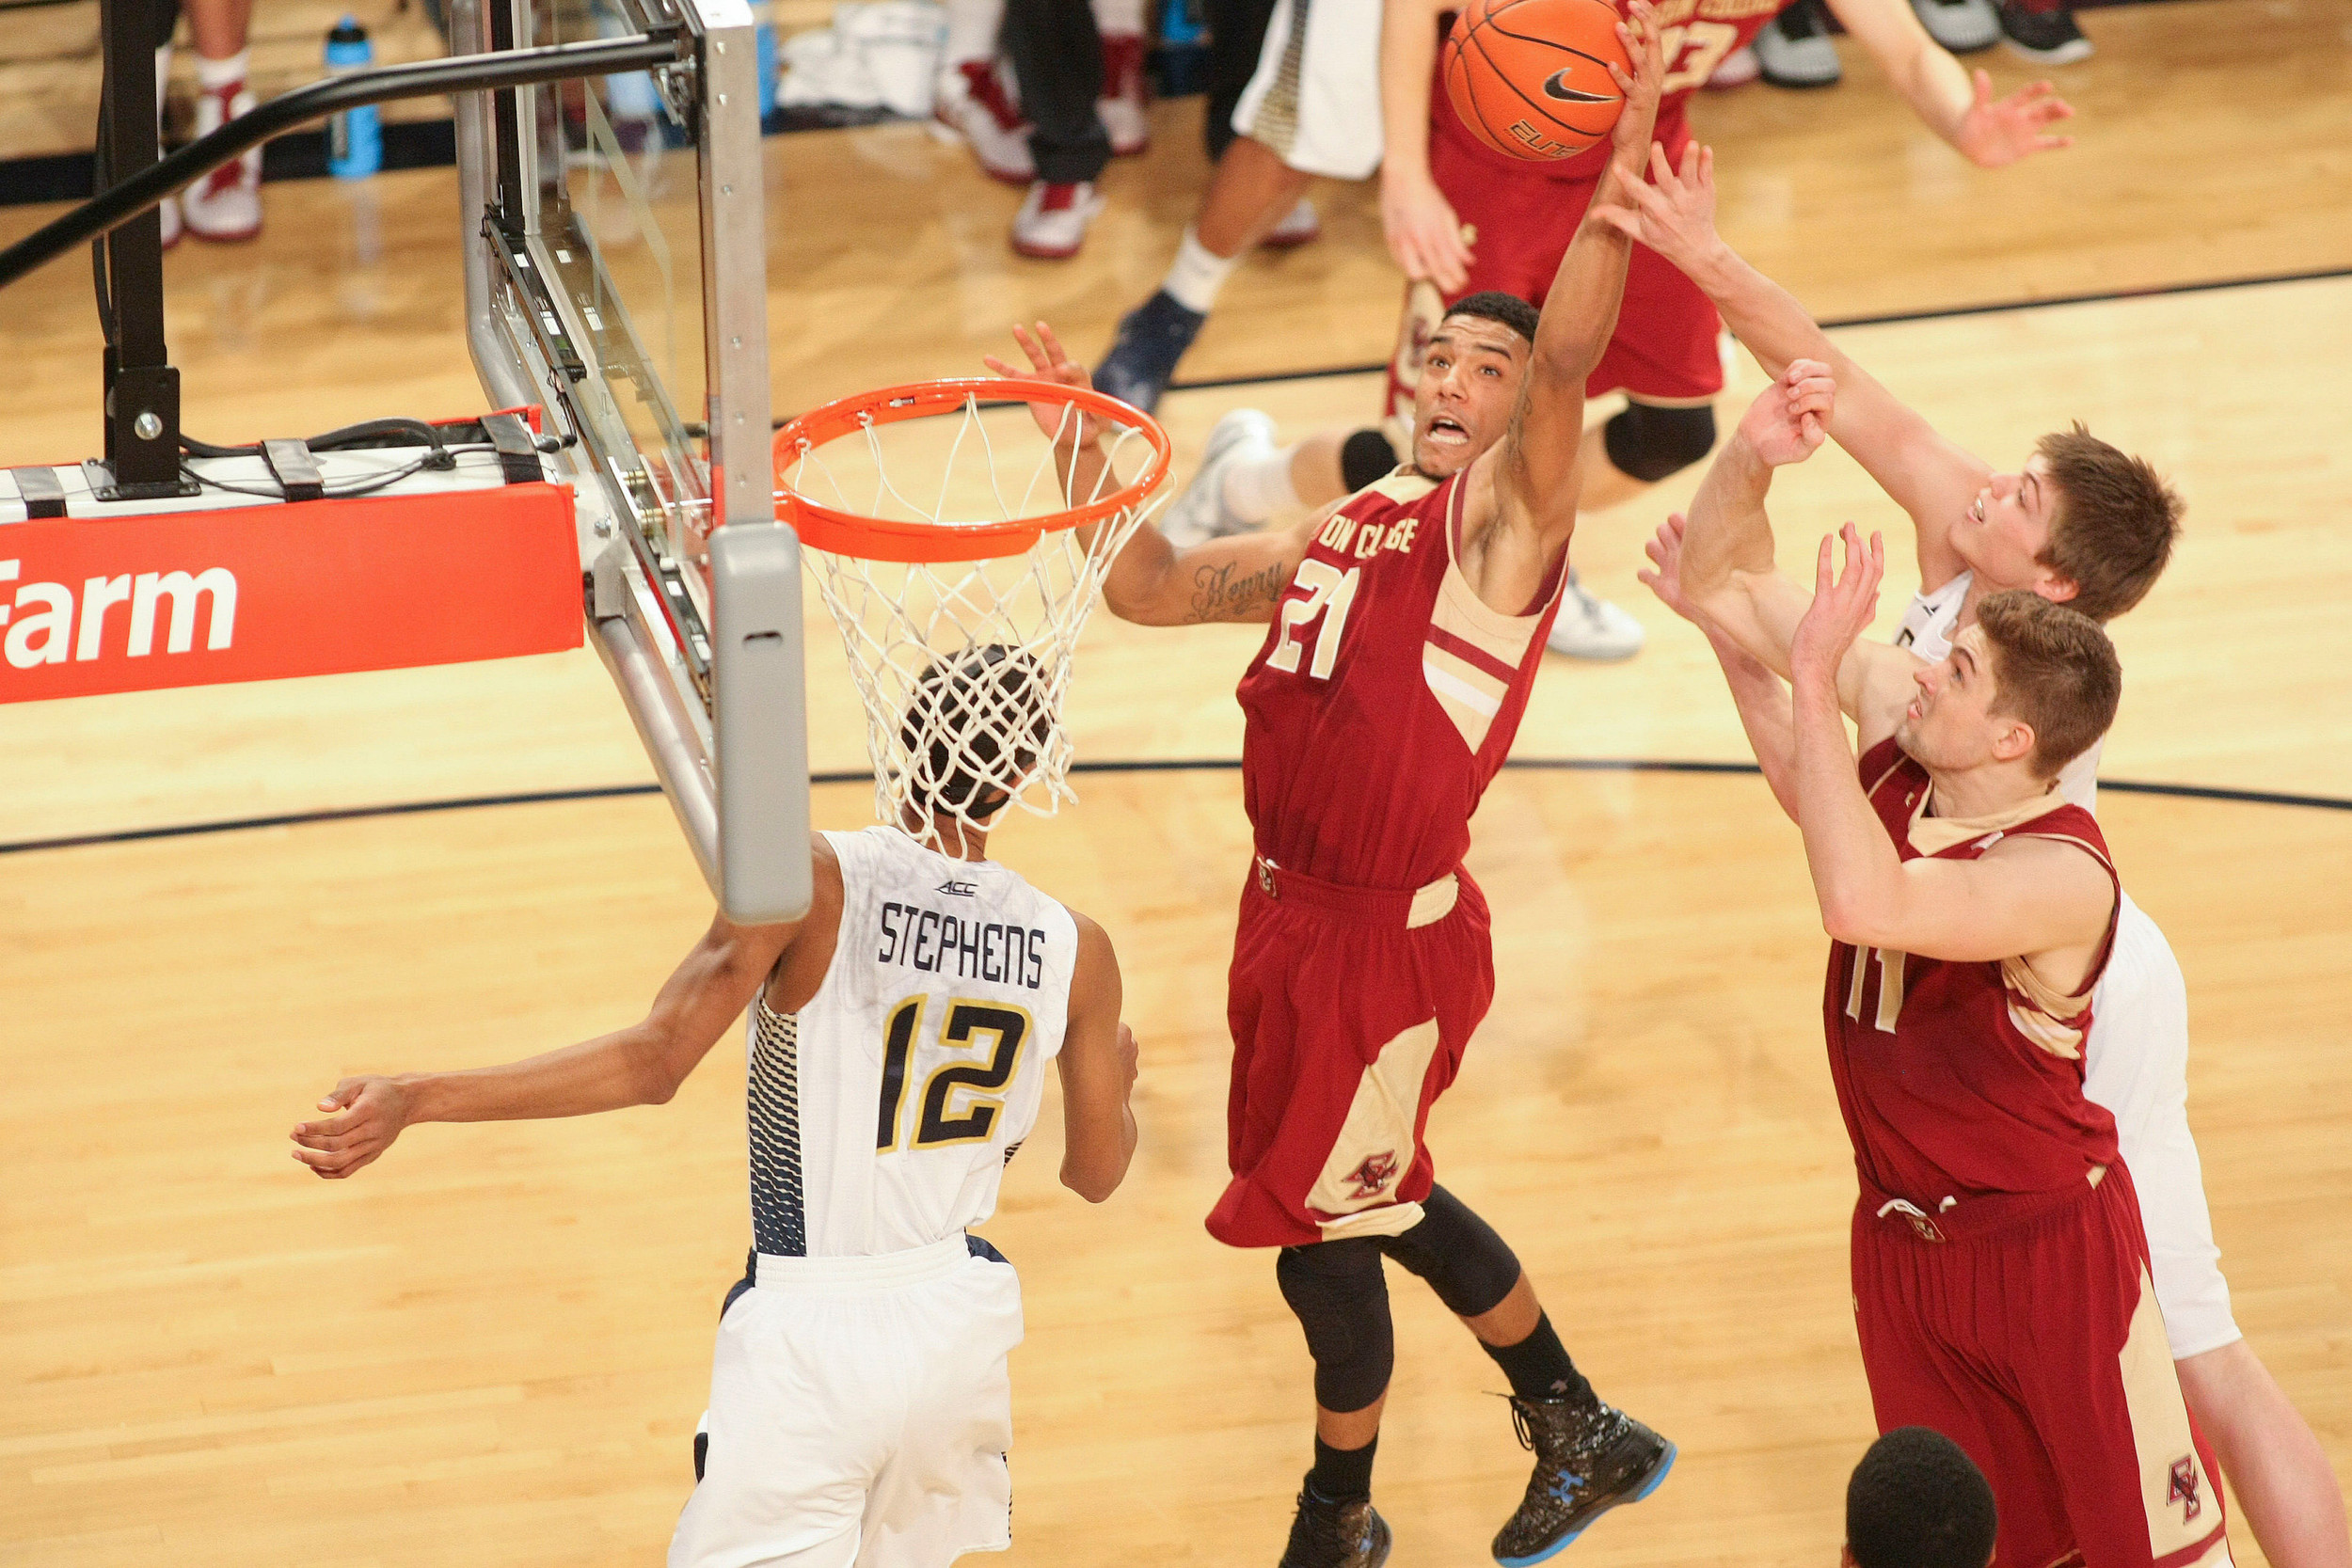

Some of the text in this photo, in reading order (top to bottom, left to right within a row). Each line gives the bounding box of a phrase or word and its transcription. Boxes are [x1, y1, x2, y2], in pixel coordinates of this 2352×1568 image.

[1191, 560, 1282, 621] Henry
[1265, 558, 1360, 680] 21
[934, 880, 979, 896] ACC
[878, 902, 1045, 989] STEPHENS
[876, 992, 1034, 1155] 12
